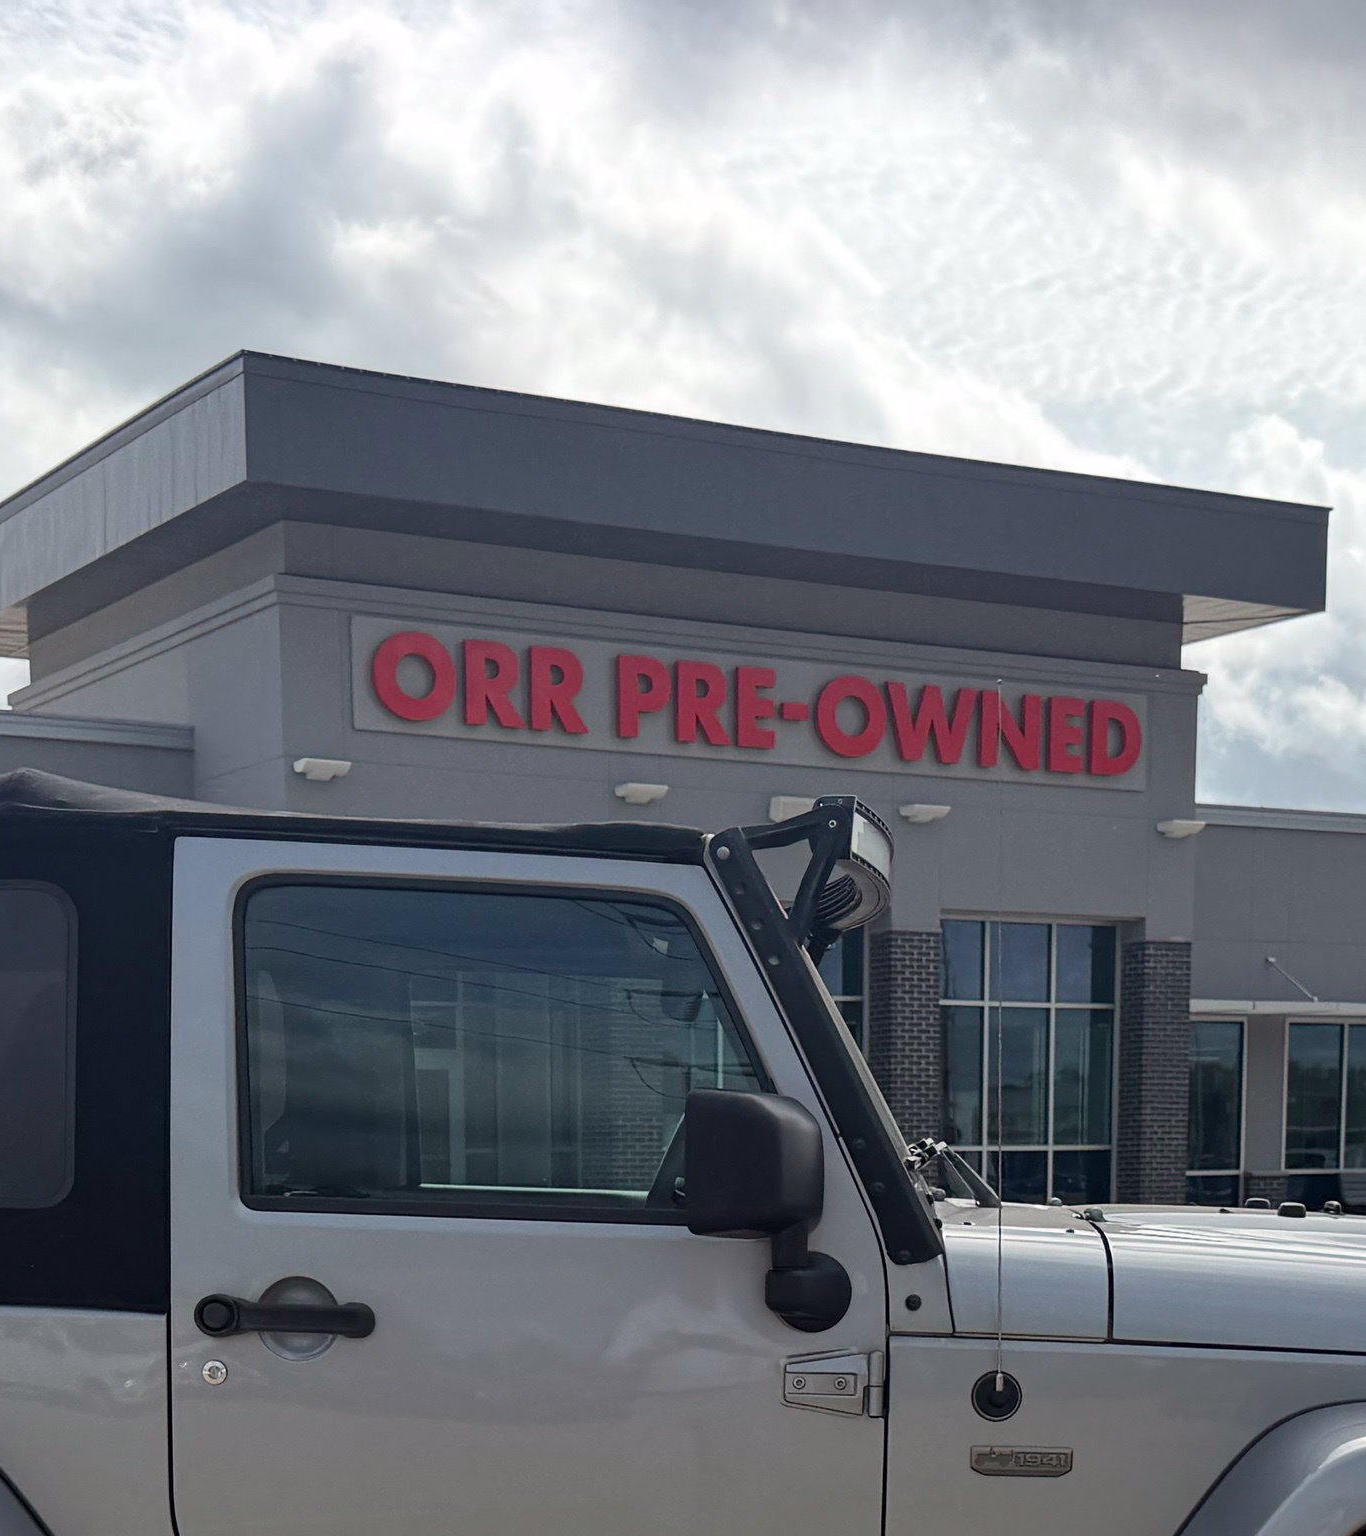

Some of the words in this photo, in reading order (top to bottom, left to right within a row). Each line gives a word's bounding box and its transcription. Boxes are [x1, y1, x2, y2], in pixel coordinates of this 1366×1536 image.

[372, 631, 590, 735] ORR
[617, 654, 1142, 777] PRE-OWNED
[1017, 1453, 1066, 1467] 1941
